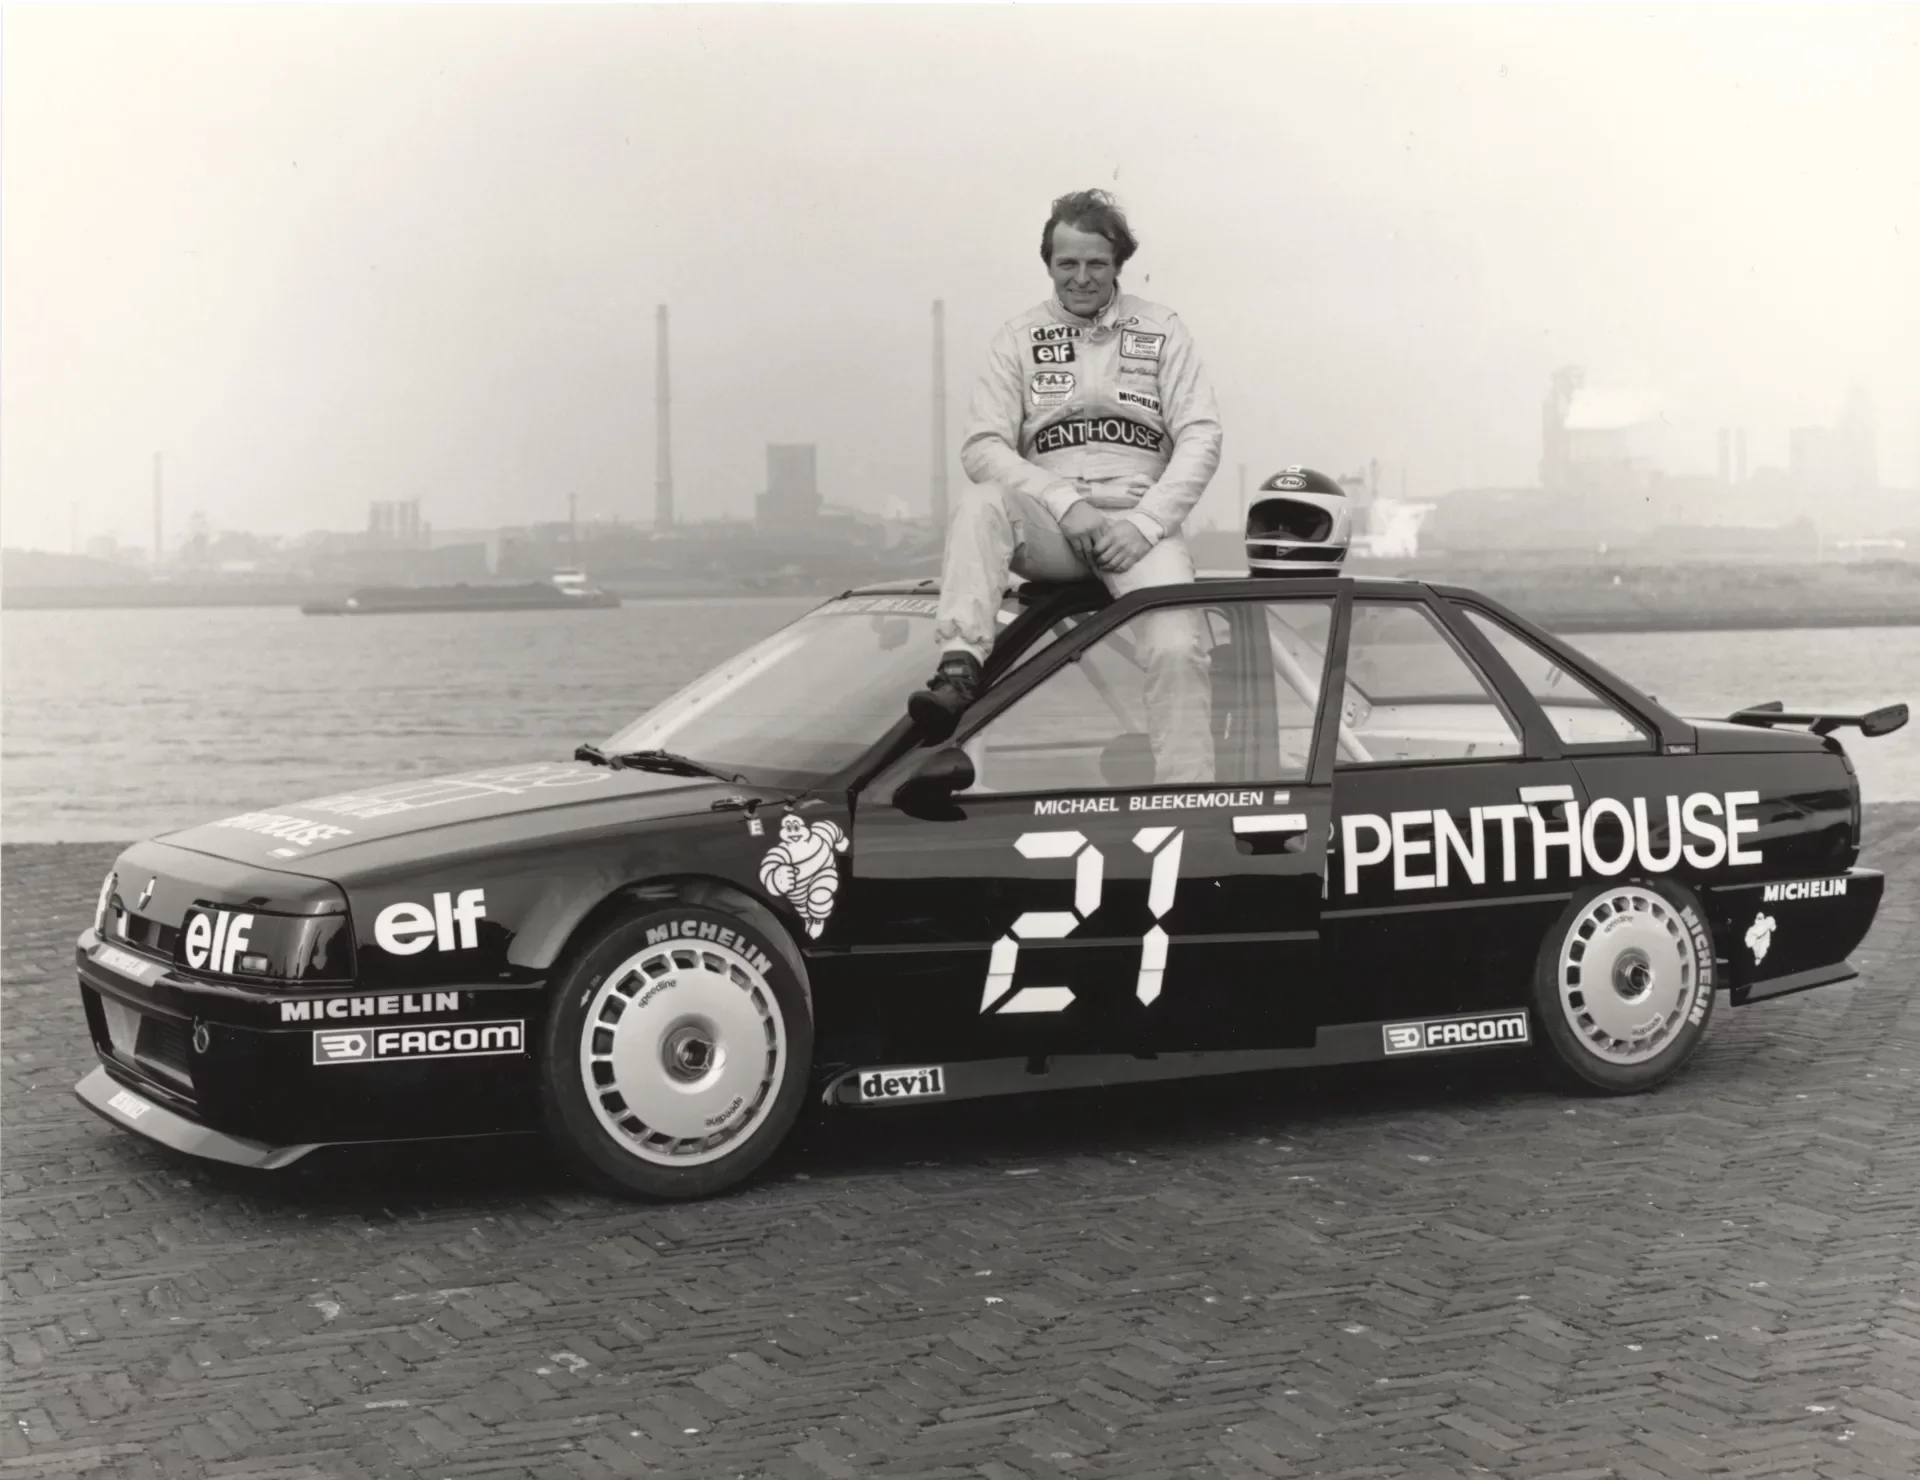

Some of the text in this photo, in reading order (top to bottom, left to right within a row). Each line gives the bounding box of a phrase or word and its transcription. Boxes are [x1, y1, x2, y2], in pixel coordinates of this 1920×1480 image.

[1037, 344, 1071, 361] elf
[1119, 391, 1160, 411] MICHELIN
[1037, 419, 1163, 450] PENTHOUSE
[1034, 791, 1264, 816] MICHAEL BLEEKEMOLEN
[1341, 791, 1763, 895] PENTHOUSE
[1763, 878, 1848, 902] MICHELIN
[374, 888, 487, 956] elf
[979, 826, 1184, 1014] 21
[185, 911, 254, 974] elf
[646, 920, 773, 977] MICHELIN
[1680, 905, 1713, 1027] MICHELIN
[280, 991, 459, 1022] MICHELIN
[638, 979, 677, 1008] speedline
[863, 1068, 942, 1098] devil
